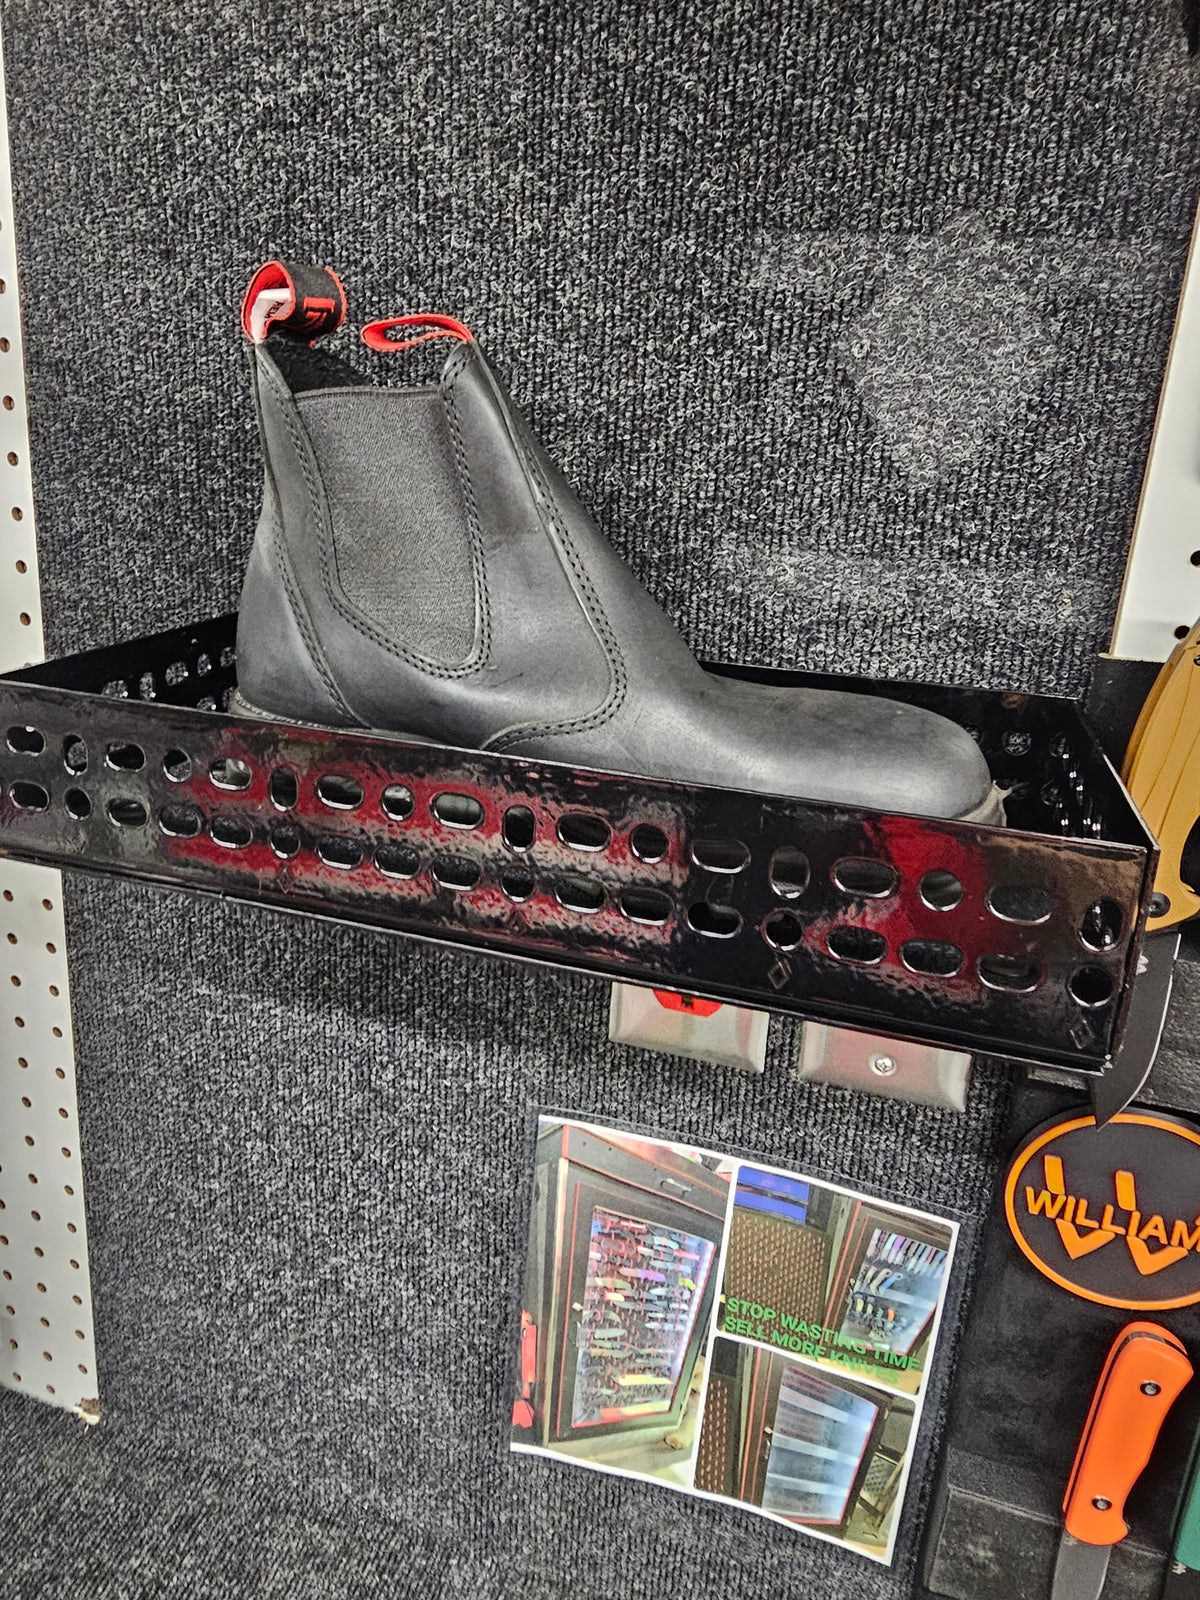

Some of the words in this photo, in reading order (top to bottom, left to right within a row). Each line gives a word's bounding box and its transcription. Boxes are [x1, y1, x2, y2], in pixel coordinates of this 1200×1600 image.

[724, 1316, 768, 1340] SELL
[771, 1330, 826, 1358] MORE
[829, 1349, 900, 1384] KNIVES
[726, 1296, 777, 1321] STOP
[780, 1312, 867, 1355] WASTING
[873, 1343, 921, 1371] TIME
